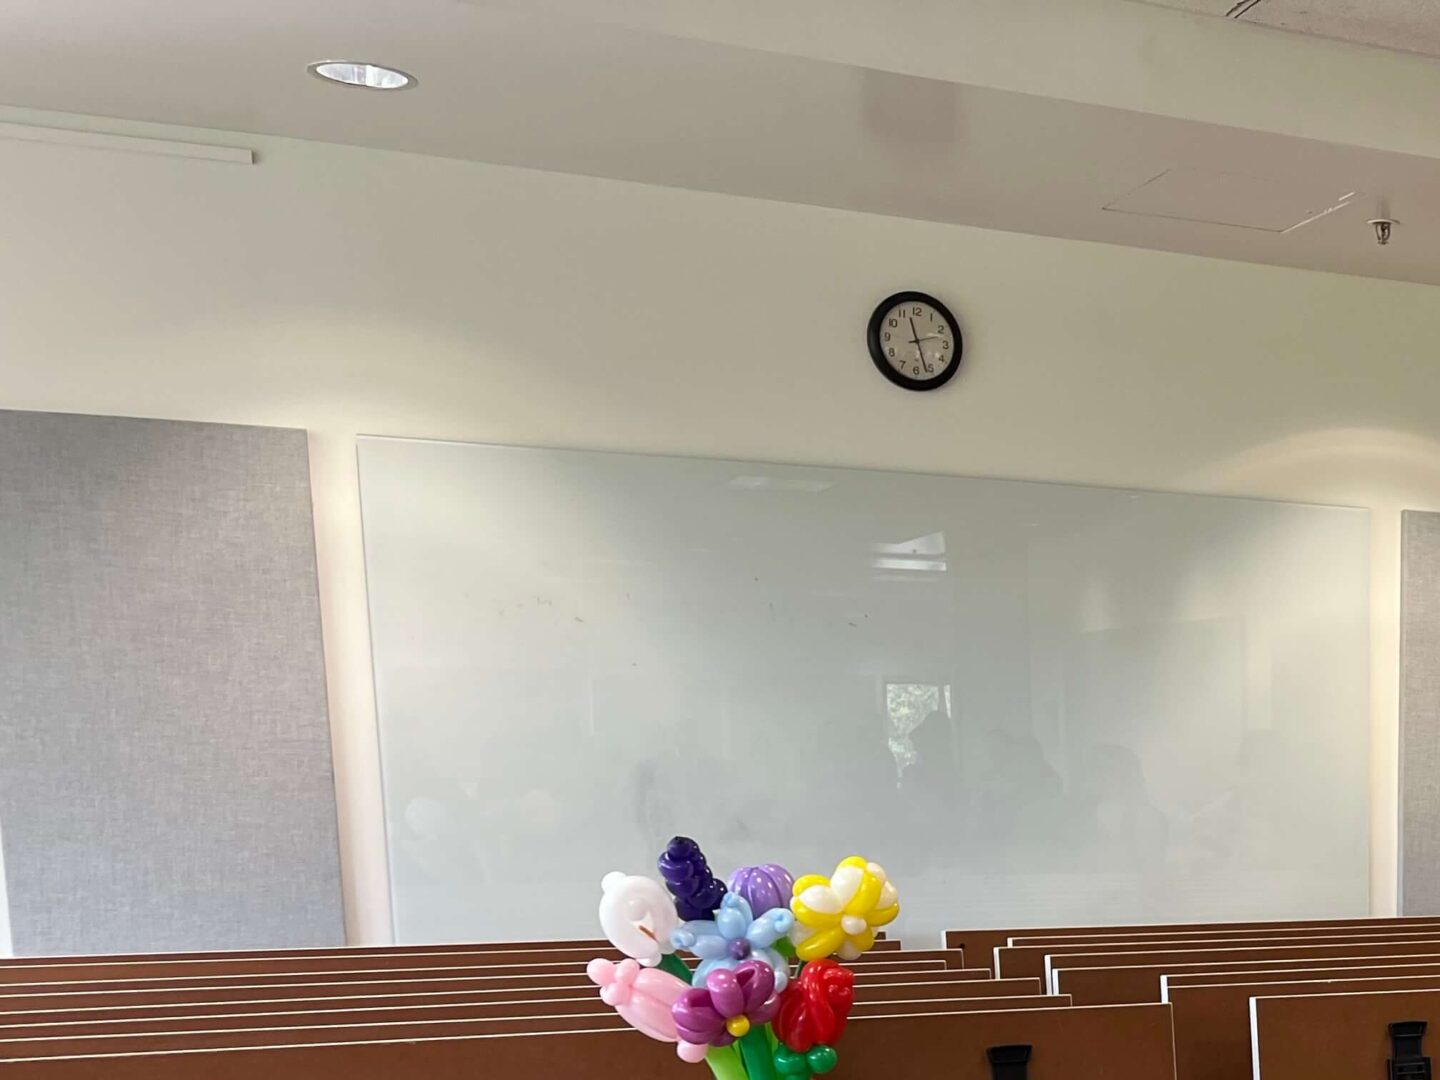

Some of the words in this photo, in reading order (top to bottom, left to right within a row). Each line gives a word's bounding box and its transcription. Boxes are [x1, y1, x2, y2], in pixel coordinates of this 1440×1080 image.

[898, 309, 906, 318] 11
[912, 307, 922, 317] 12
[888, 318, 898, 328] 10
[937, 325, 945, 334] 2
[884, 332, 891, 341] 9
[942, 340, 949, 350] 3
[888, 347, 895, 357] 8
[899, 360, 906, 369] 7
[927, 364, 934, 373] 5
[912, 366, 920, 375] 6
